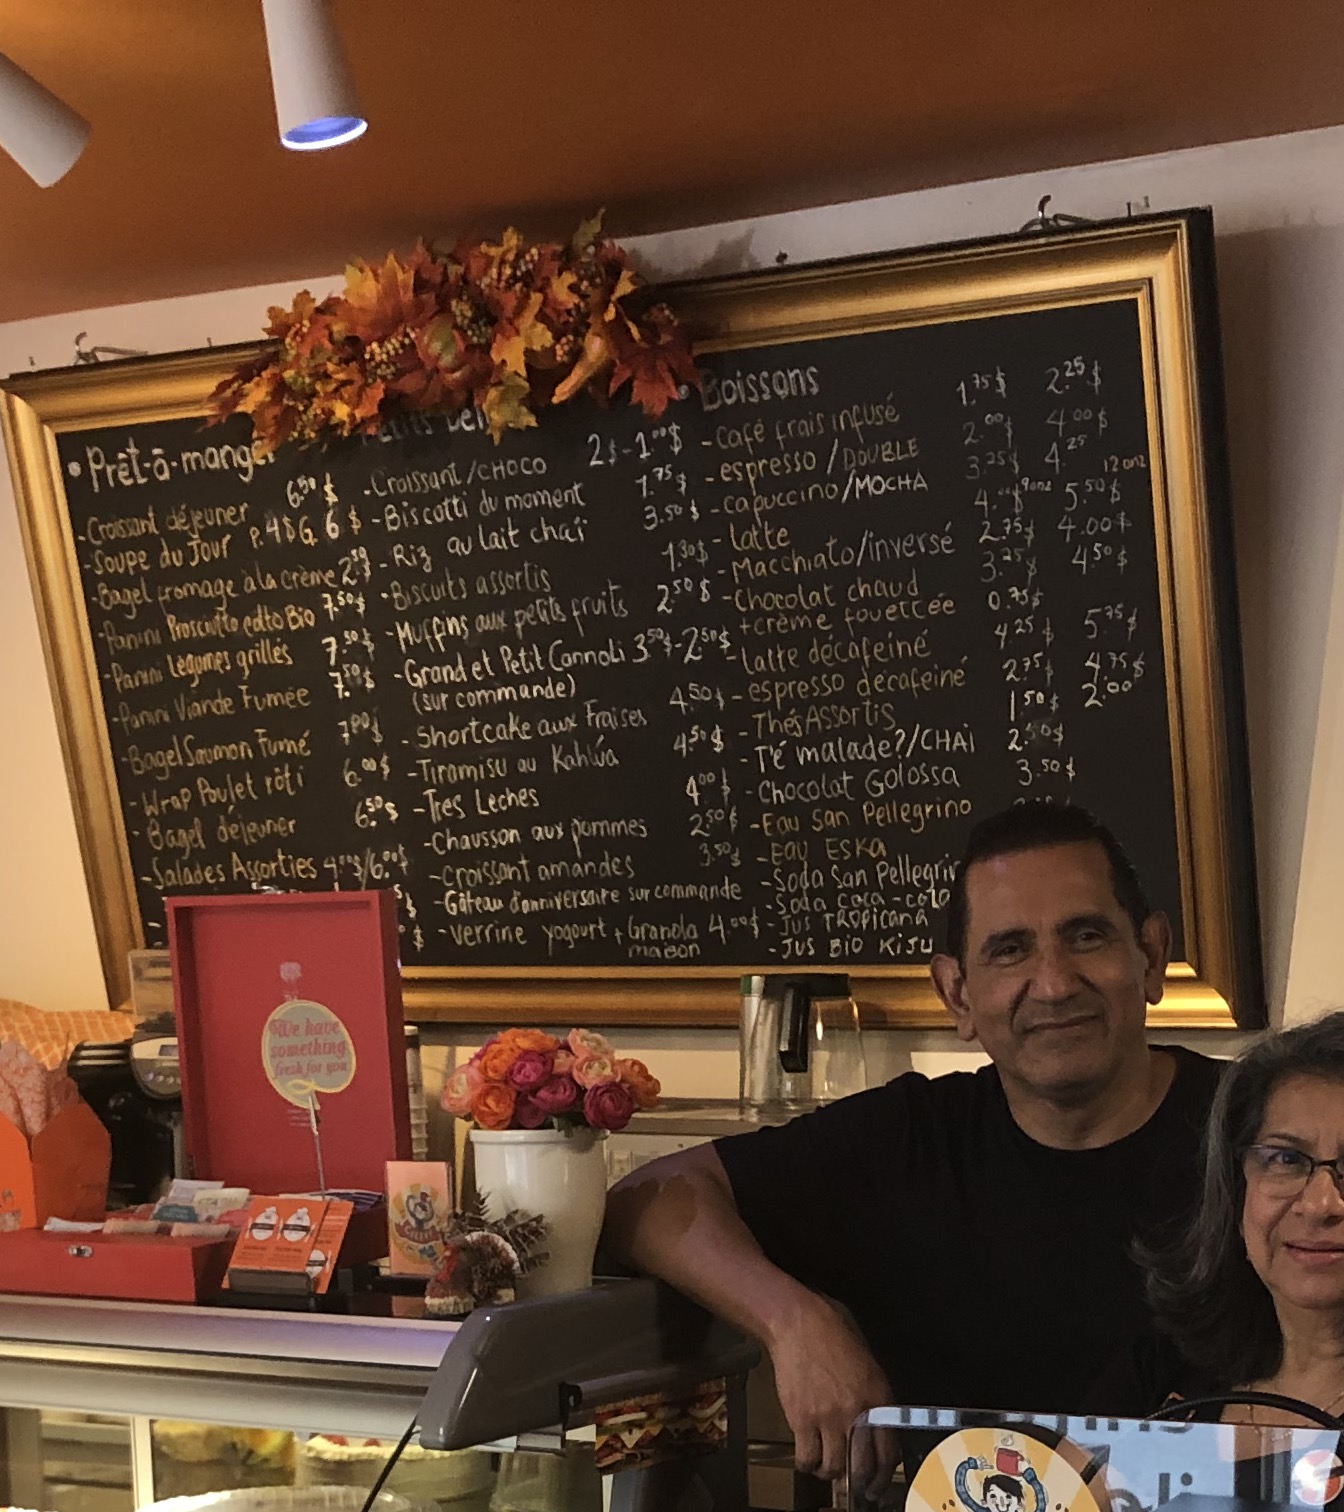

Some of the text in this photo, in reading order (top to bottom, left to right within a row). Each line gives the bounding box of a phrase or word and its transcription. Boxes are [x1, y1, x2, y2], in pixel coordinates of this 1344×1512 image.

[702, 365, 820, 412] Boissons
[716, 391, 900, 454] Café frais infusé
[369, 463, 462, 498] Croissant
[720, 451, 817, 496] espresso
[86, 502, 250, 546] Croissant déjeuner
[384, 480, 587, 533] Biscotti du moment
[477, 517, 521, 552] lait
[730, 520, 791, 551] latte
[93, 549, 150, 576] Soupe
[159, 537, 183, 568] du
[96, 578, 154, 620] Bagel
[389, 558, 552, 612] Biscuits assortis
[735, 568, 920, 613] Chocolat chaud
[395, 612, 469, 653] Muffins
[514, 596, 567, 641] petits
[571, 579, 630, 638] fruits
[105, 621, 162, 656] Panini
[111, 662, 164, 693] Panini
[404, 651, 468, 689] Grand
[472, 654, 495, 681] et
[500, 643, 546, 675] Petit
[741, 645, 800, 675] latte
[748, 672, 846, 711] espresso
[118, 701, 170, 736] Panini
[174, 688, 235, 722] Viande
[416, 711, 532, 751] Shortcake
[752, 708, 803, 739] Thés
[127, 735, 182, 785] Bagel
[415, 756, 507, 786] Tiramisu
[196, 771, 258, 806] Poulet
[474, 785, 541, 815] Leches
[758, 762, 961, 805] Chocolat Golossa
[146, 805, 298, 861] Bagel déjeuner
[761, 797, 973, 837] Eau San Pellegrino
[430, 827, 522, 857] Chausson
[570, 815, 649, 859] pommes
[771, 841, 807, 866] Eau
[151, 848, 318, 891] Salades Assorties
[537, 850, 637, 883] amandes
[773, 862, 825, 893] Soda
[831, 864, 868, 889] San
[627, 884, 652, 902] sur
[654, 874, 744, 902] commande
[775, 892, 827, 915] Soda
[540, 915, 608, 958] yogourt
[627, 941, 702, 961] maison
[267, 1016, 341, 1038] We have
[269, 1037, 349, 1059] something
[274, 1061, 348, 1079] fresh for you
